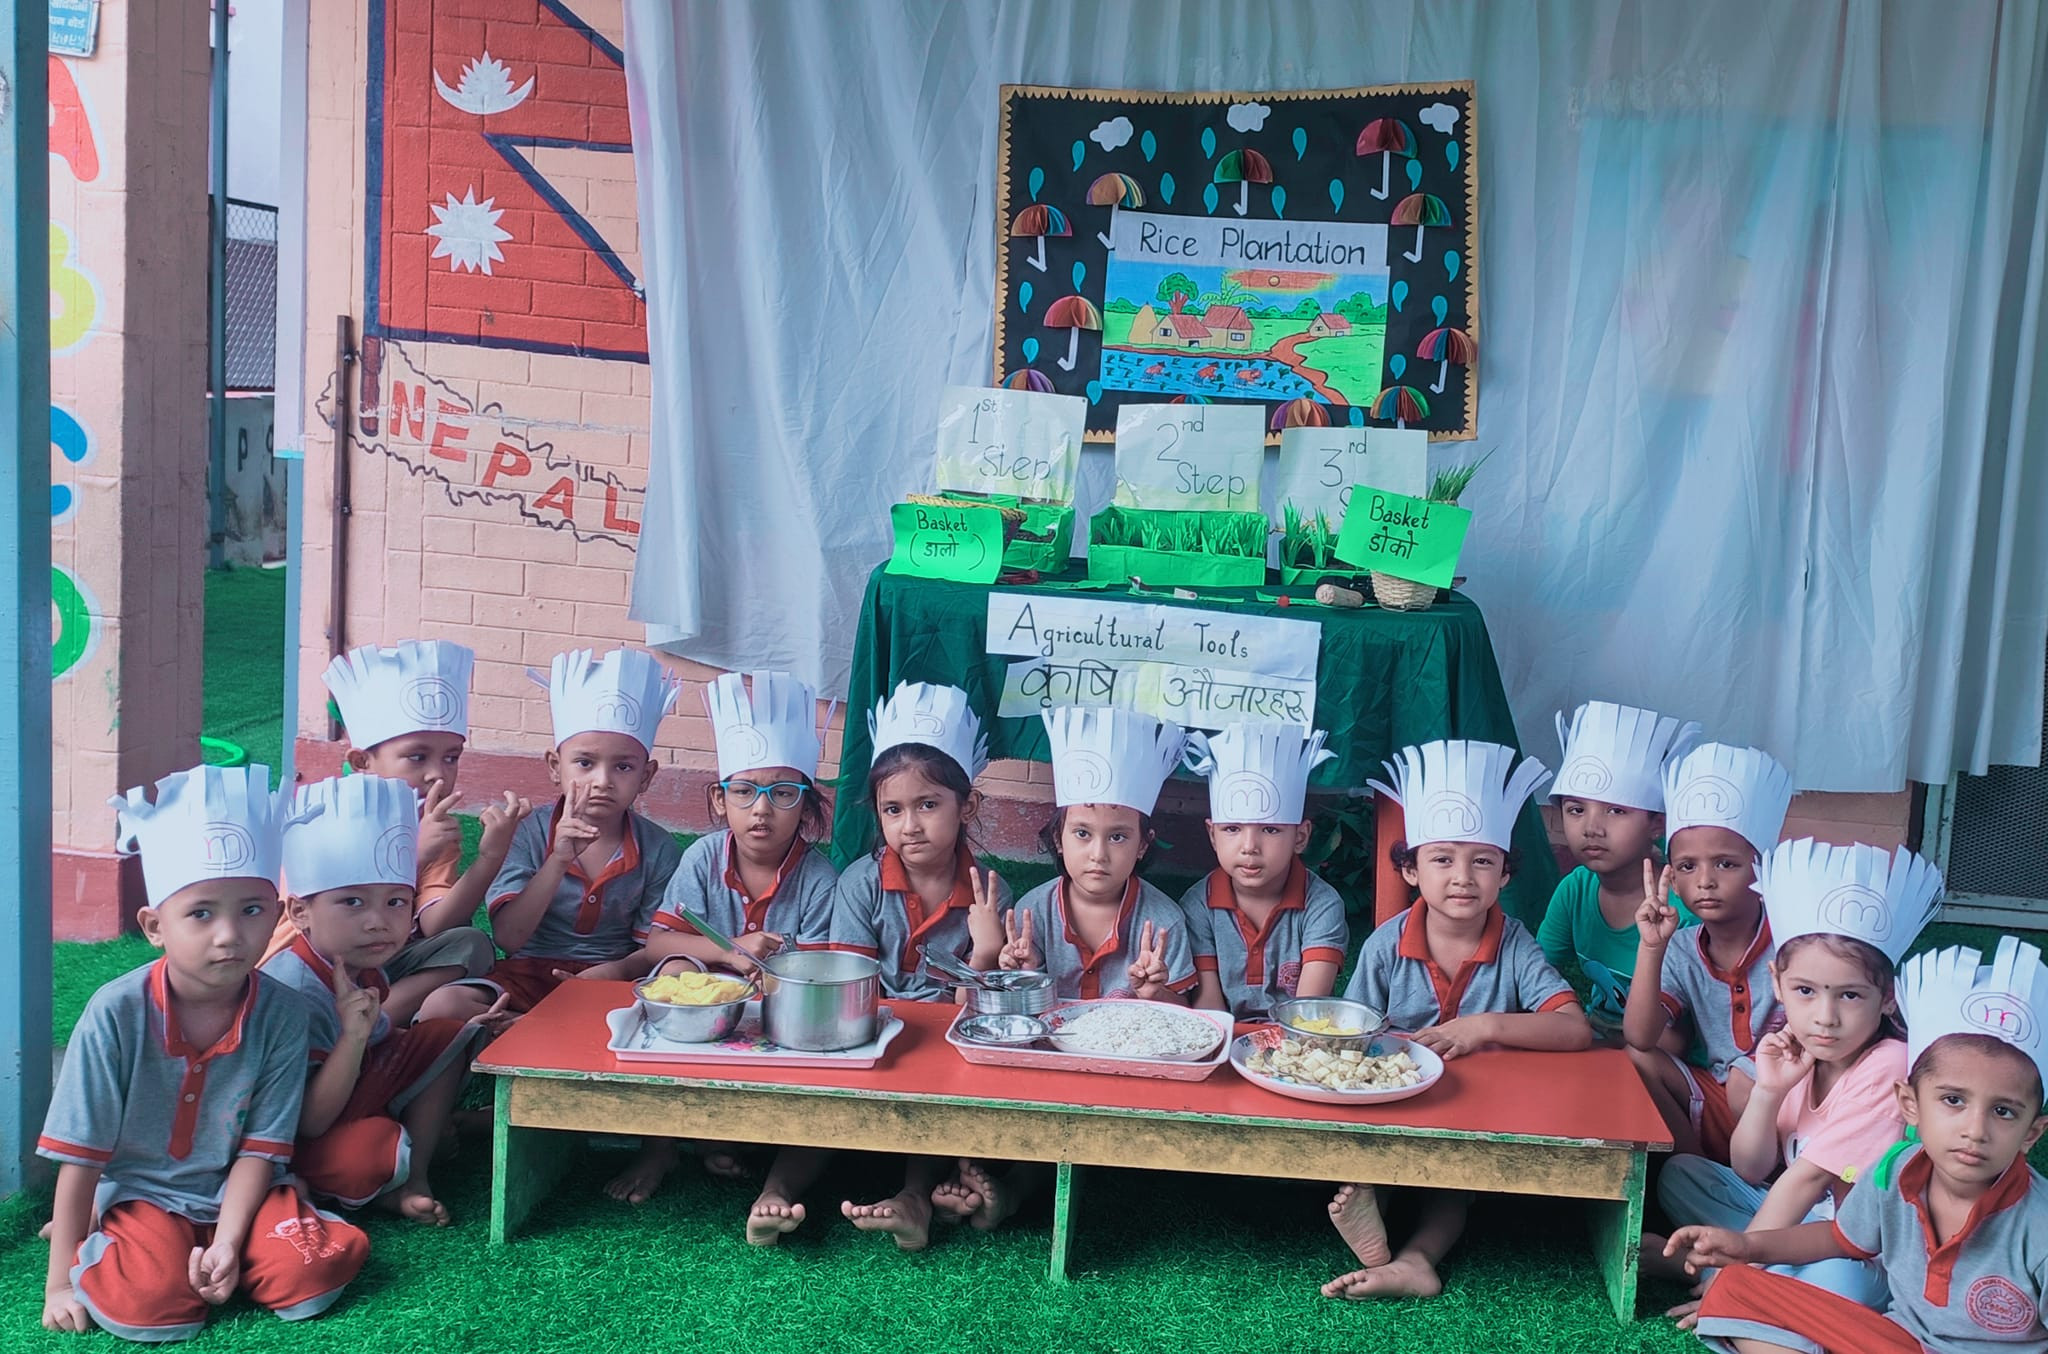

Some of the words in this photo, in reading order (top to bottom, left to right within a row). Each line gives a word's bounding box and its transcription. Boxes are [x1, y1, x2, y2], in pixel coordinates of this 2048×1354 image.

[1139, 221, 1199, 256] Rice
[1220, 227, 1366, 265] Plantation
[389, 380, 641, 534] NEPAL
[1156, 405, 1205, 463] 2nd
[979, 444, 1052, 489] Step
[1175, 461, 1246, 509] Step
[1318, 438, 1367, 488] 3rd
[916, 509, 968, 532] Basket
[1369, 494, 1430, 529] Basket
[1008, 602, 1165, 657] Agricultural
[1194, 622, 1249, 659] Tools
[1020, 658, 1119, 709] कृषि
